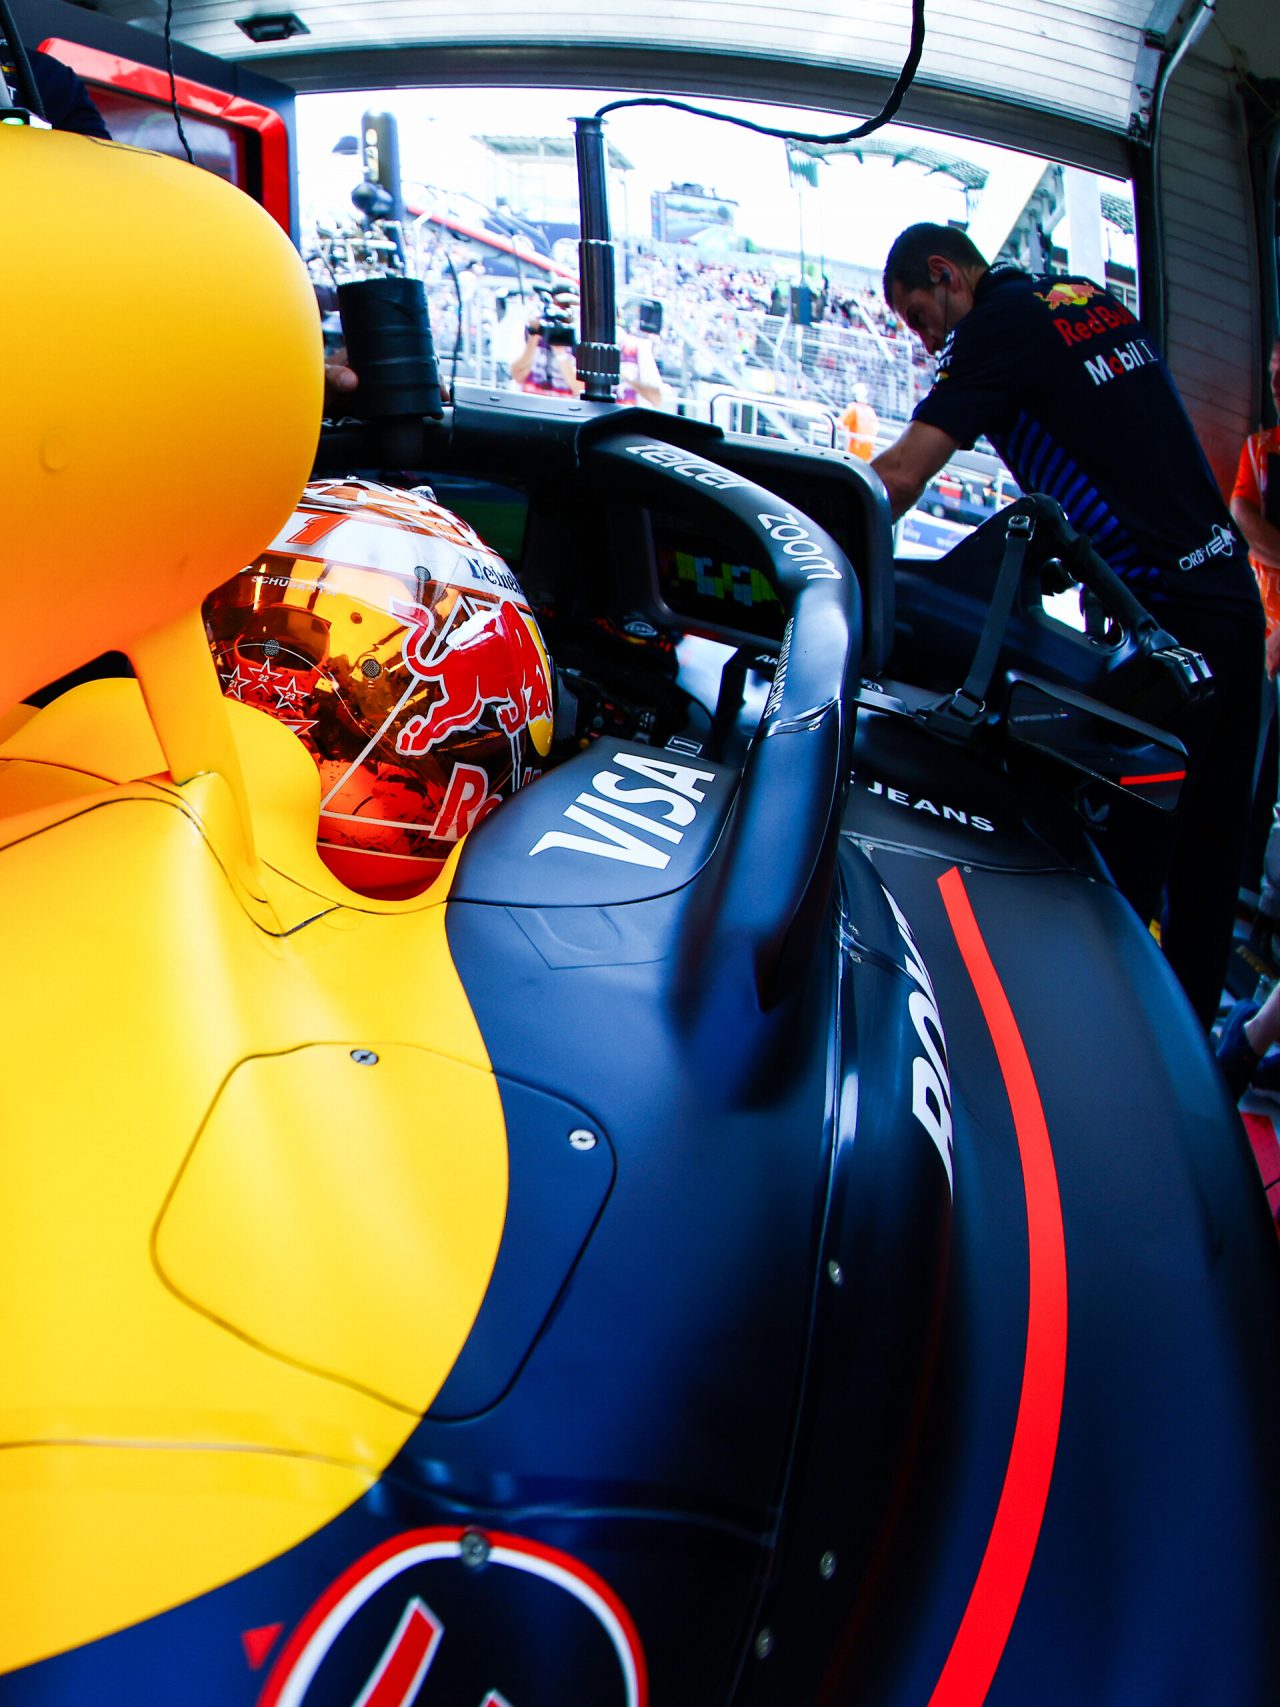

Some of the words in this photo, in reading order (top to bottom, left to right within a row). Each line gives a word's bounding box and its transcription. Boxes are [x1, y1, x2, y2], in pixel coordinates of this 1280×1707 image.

[1052, 308, 1107, 347] Red
[1083, 340, 1145, 386] Mobil
[286, 513, 351, 546] 1
[757, 513, 842, 580] zoom
[257, 674, 270, 683] 22
[285, 691, 296, 701] 23
[528, 752, 716, 870] VISA
[867, 781, 995, 832] JEANS
